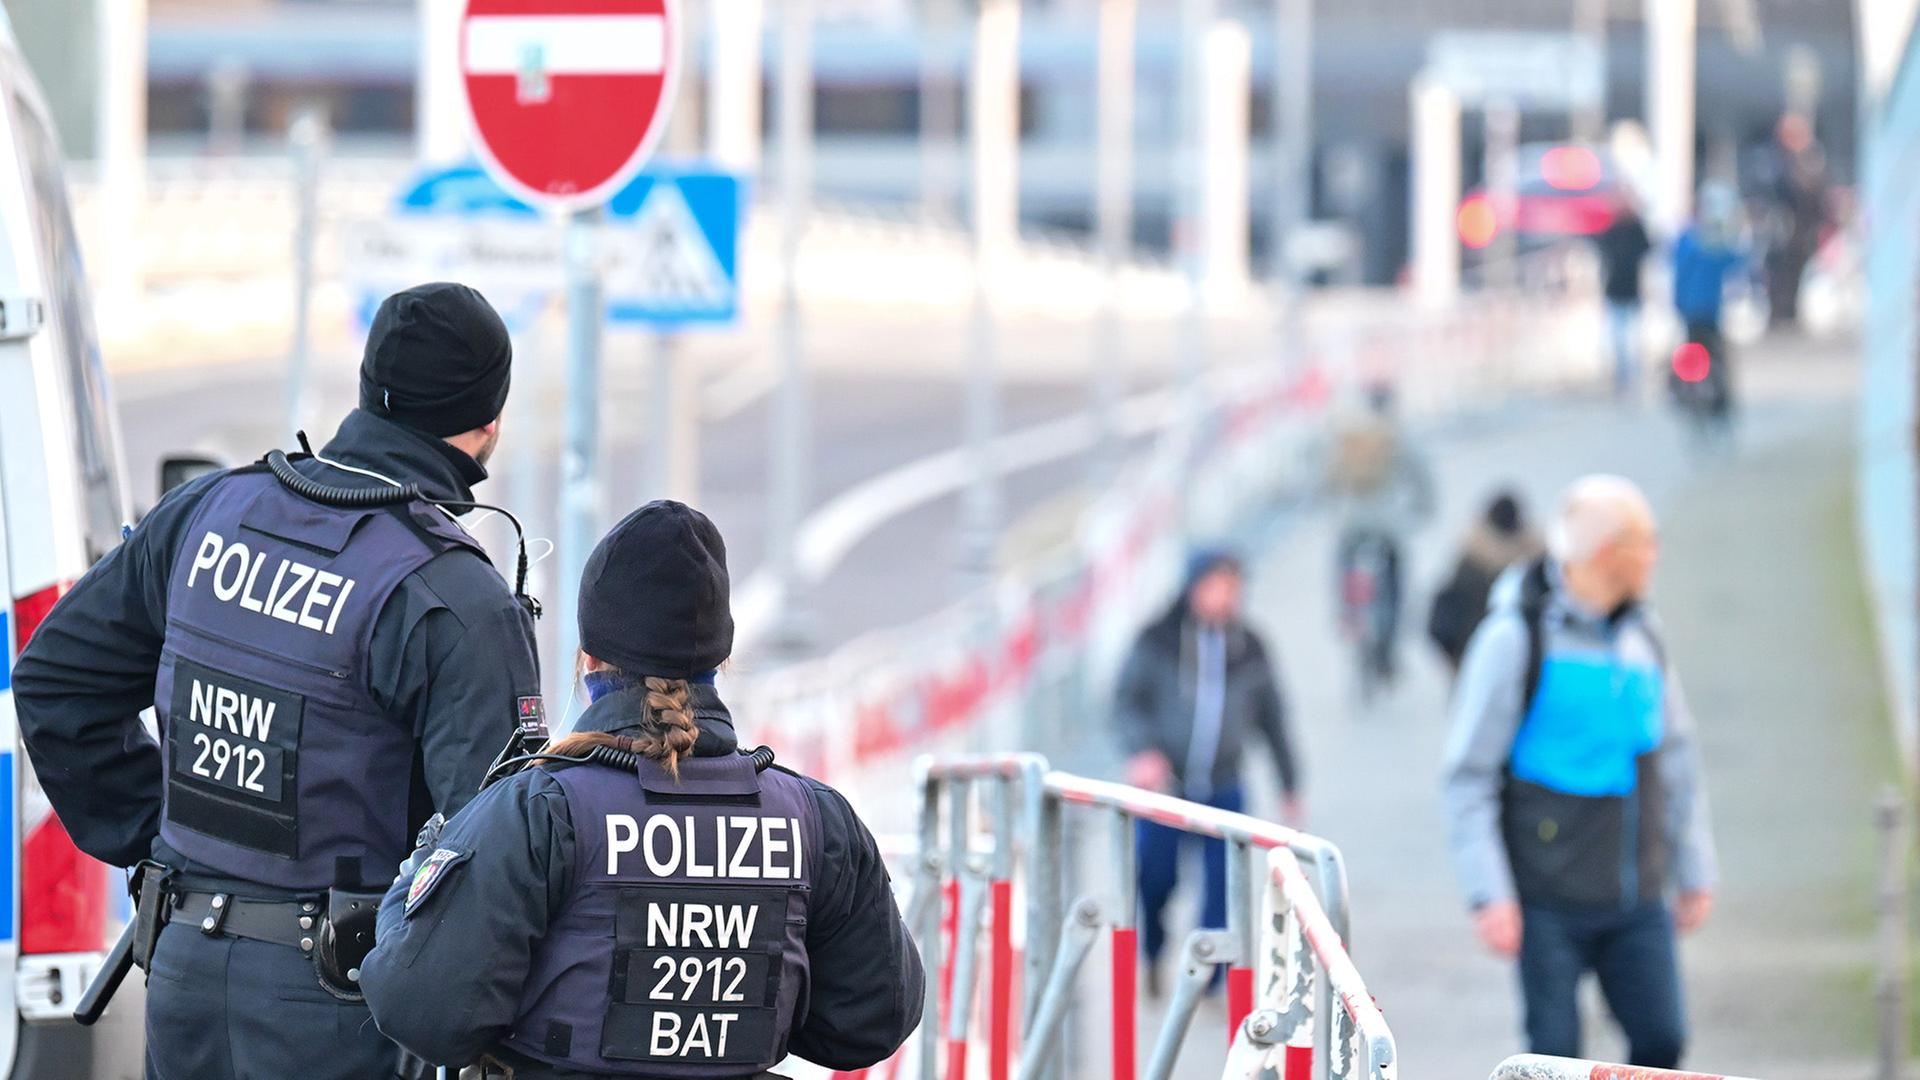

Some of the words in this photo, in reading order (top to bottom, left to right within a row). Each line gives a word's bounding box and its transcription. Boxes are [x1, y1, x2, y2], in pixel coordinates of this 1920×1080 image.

[186, 530, 356, 635] POLIZEI
[189, 679, 277, 743] NRW
[192, 732, 265, 793] 2912
[605, 813, 803, 879] POLIZEI
[647, 902, 759, 949] NRW
[649, 955, 747, 1002] 2912
[649, 1011, 739, 1058] BAT
